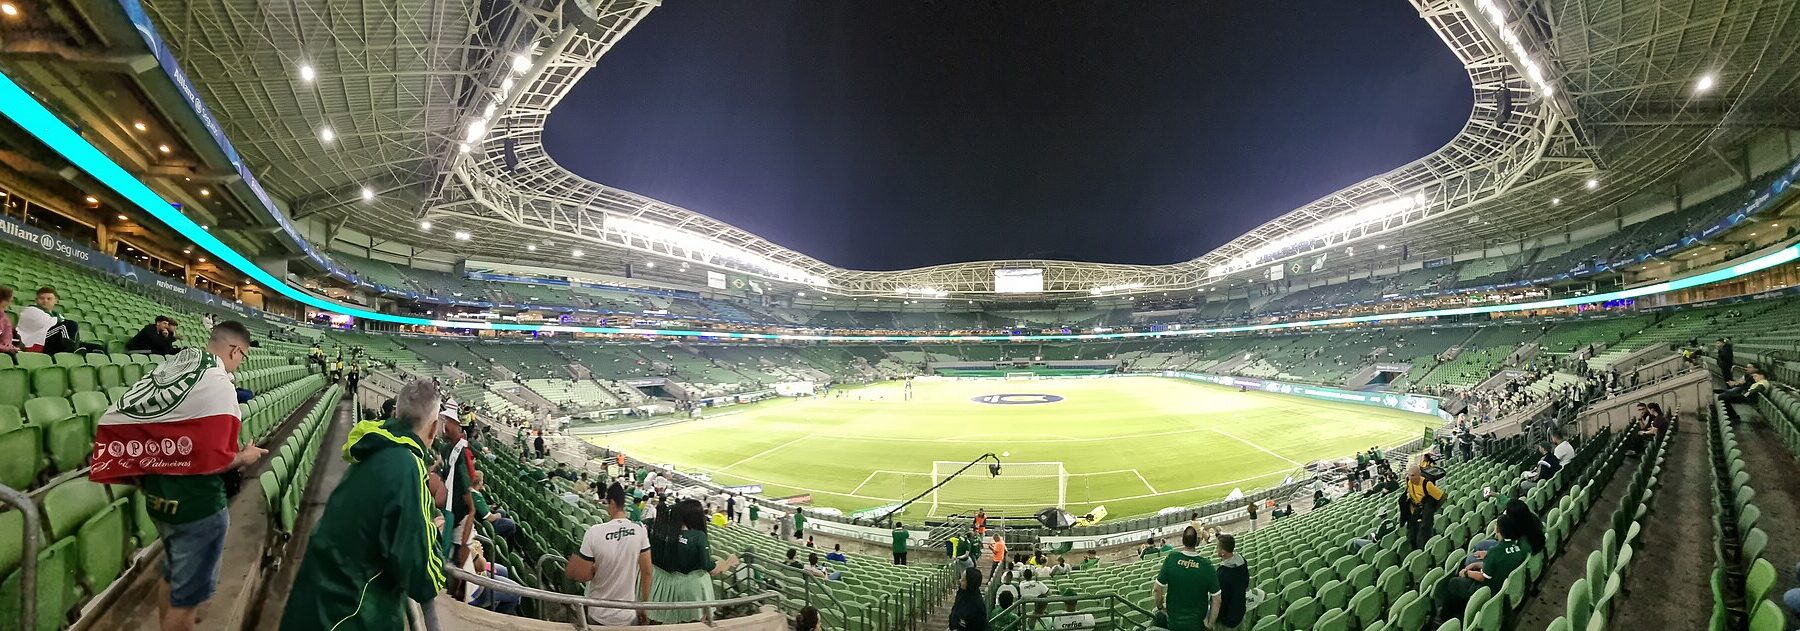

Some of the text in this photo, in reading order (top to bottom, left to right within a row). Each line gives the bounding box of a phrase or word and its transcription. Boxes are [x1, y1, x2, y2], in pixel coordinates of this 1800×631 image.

[0, 220, 89, 260] Allianz Seguros
[139, 457, 191, 468] Palmeiras
[605, 527, 635, 541] crefisa
